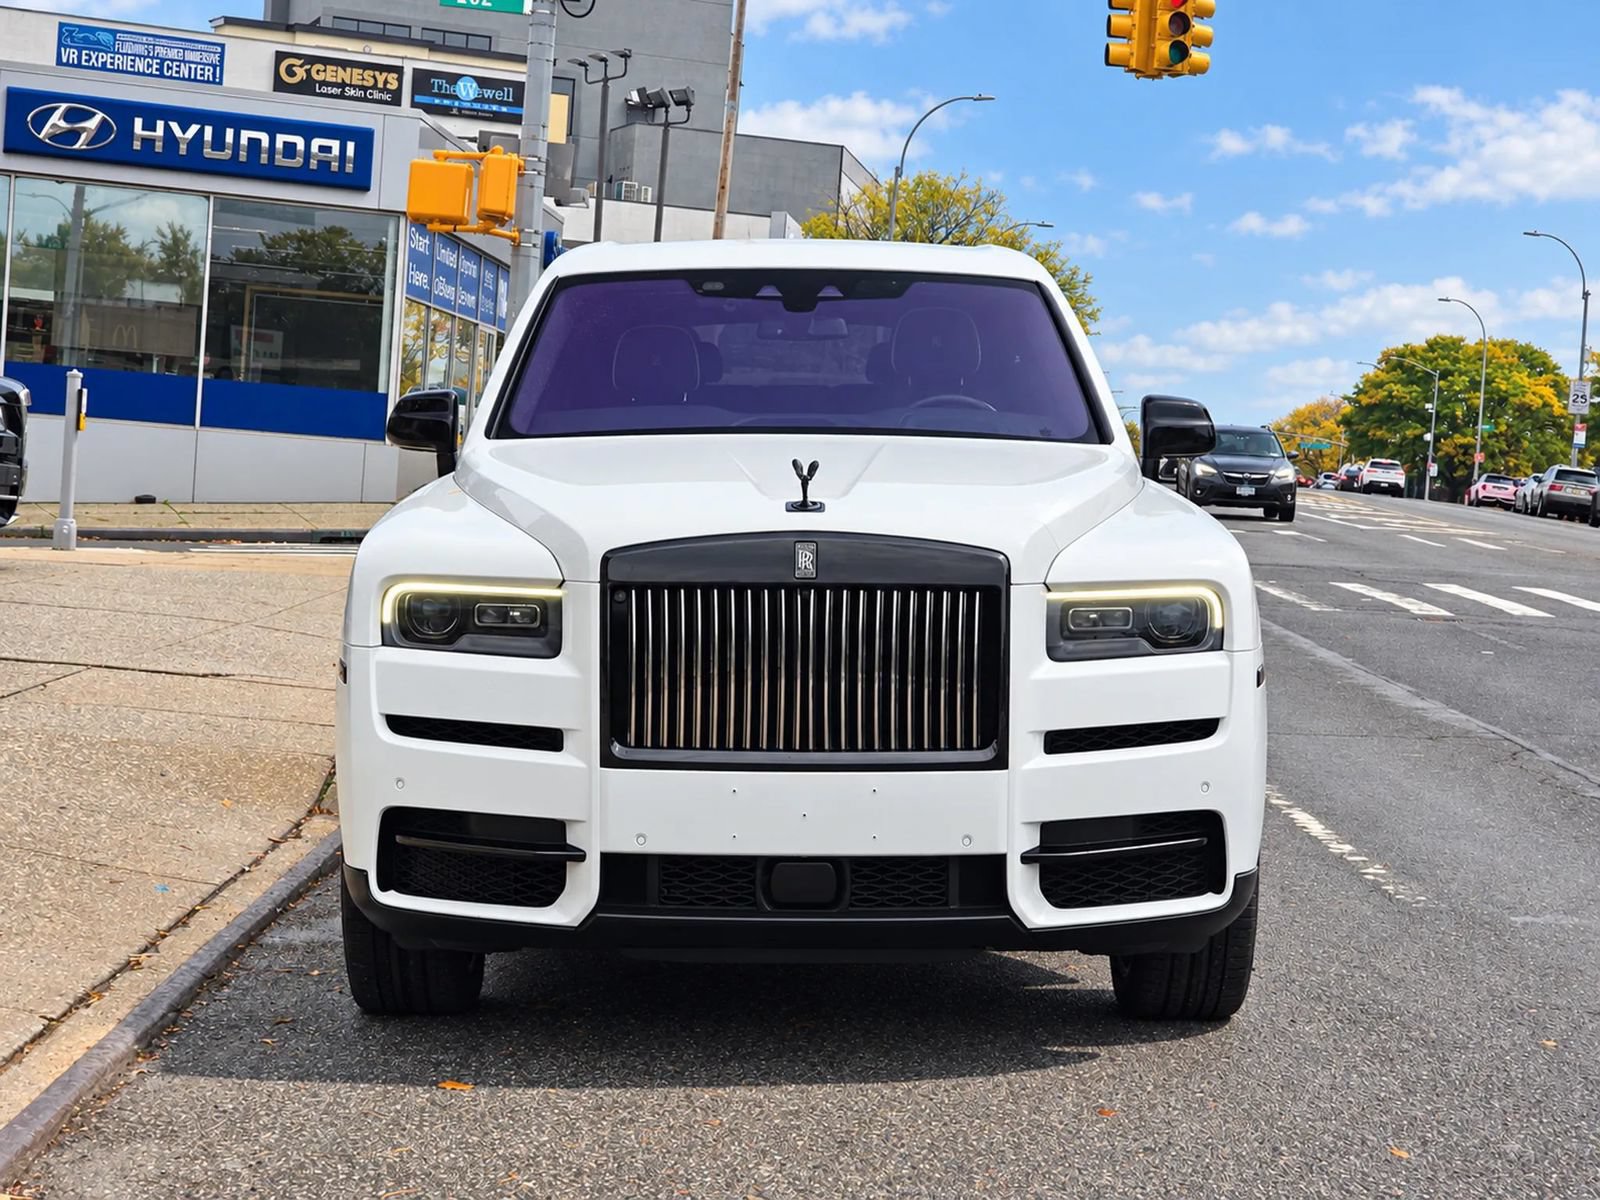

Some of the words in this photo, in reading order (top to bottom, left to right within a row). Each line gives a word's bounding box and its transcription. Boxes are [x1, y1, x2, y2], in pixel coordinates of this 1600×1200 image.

[60, 47, 78, 65] VR
[81, 50, 161, 75] EXPERIENCE
[310, 63, 399, 90] GENESYS
[315, 83, 341, 95] Laser
[344, 86, 364, 98] Skin
[366, 89, 392, 101] Clinic
[132, 116, 355, 174] HYUNDAI
[410, 227, 430, 255] Start
